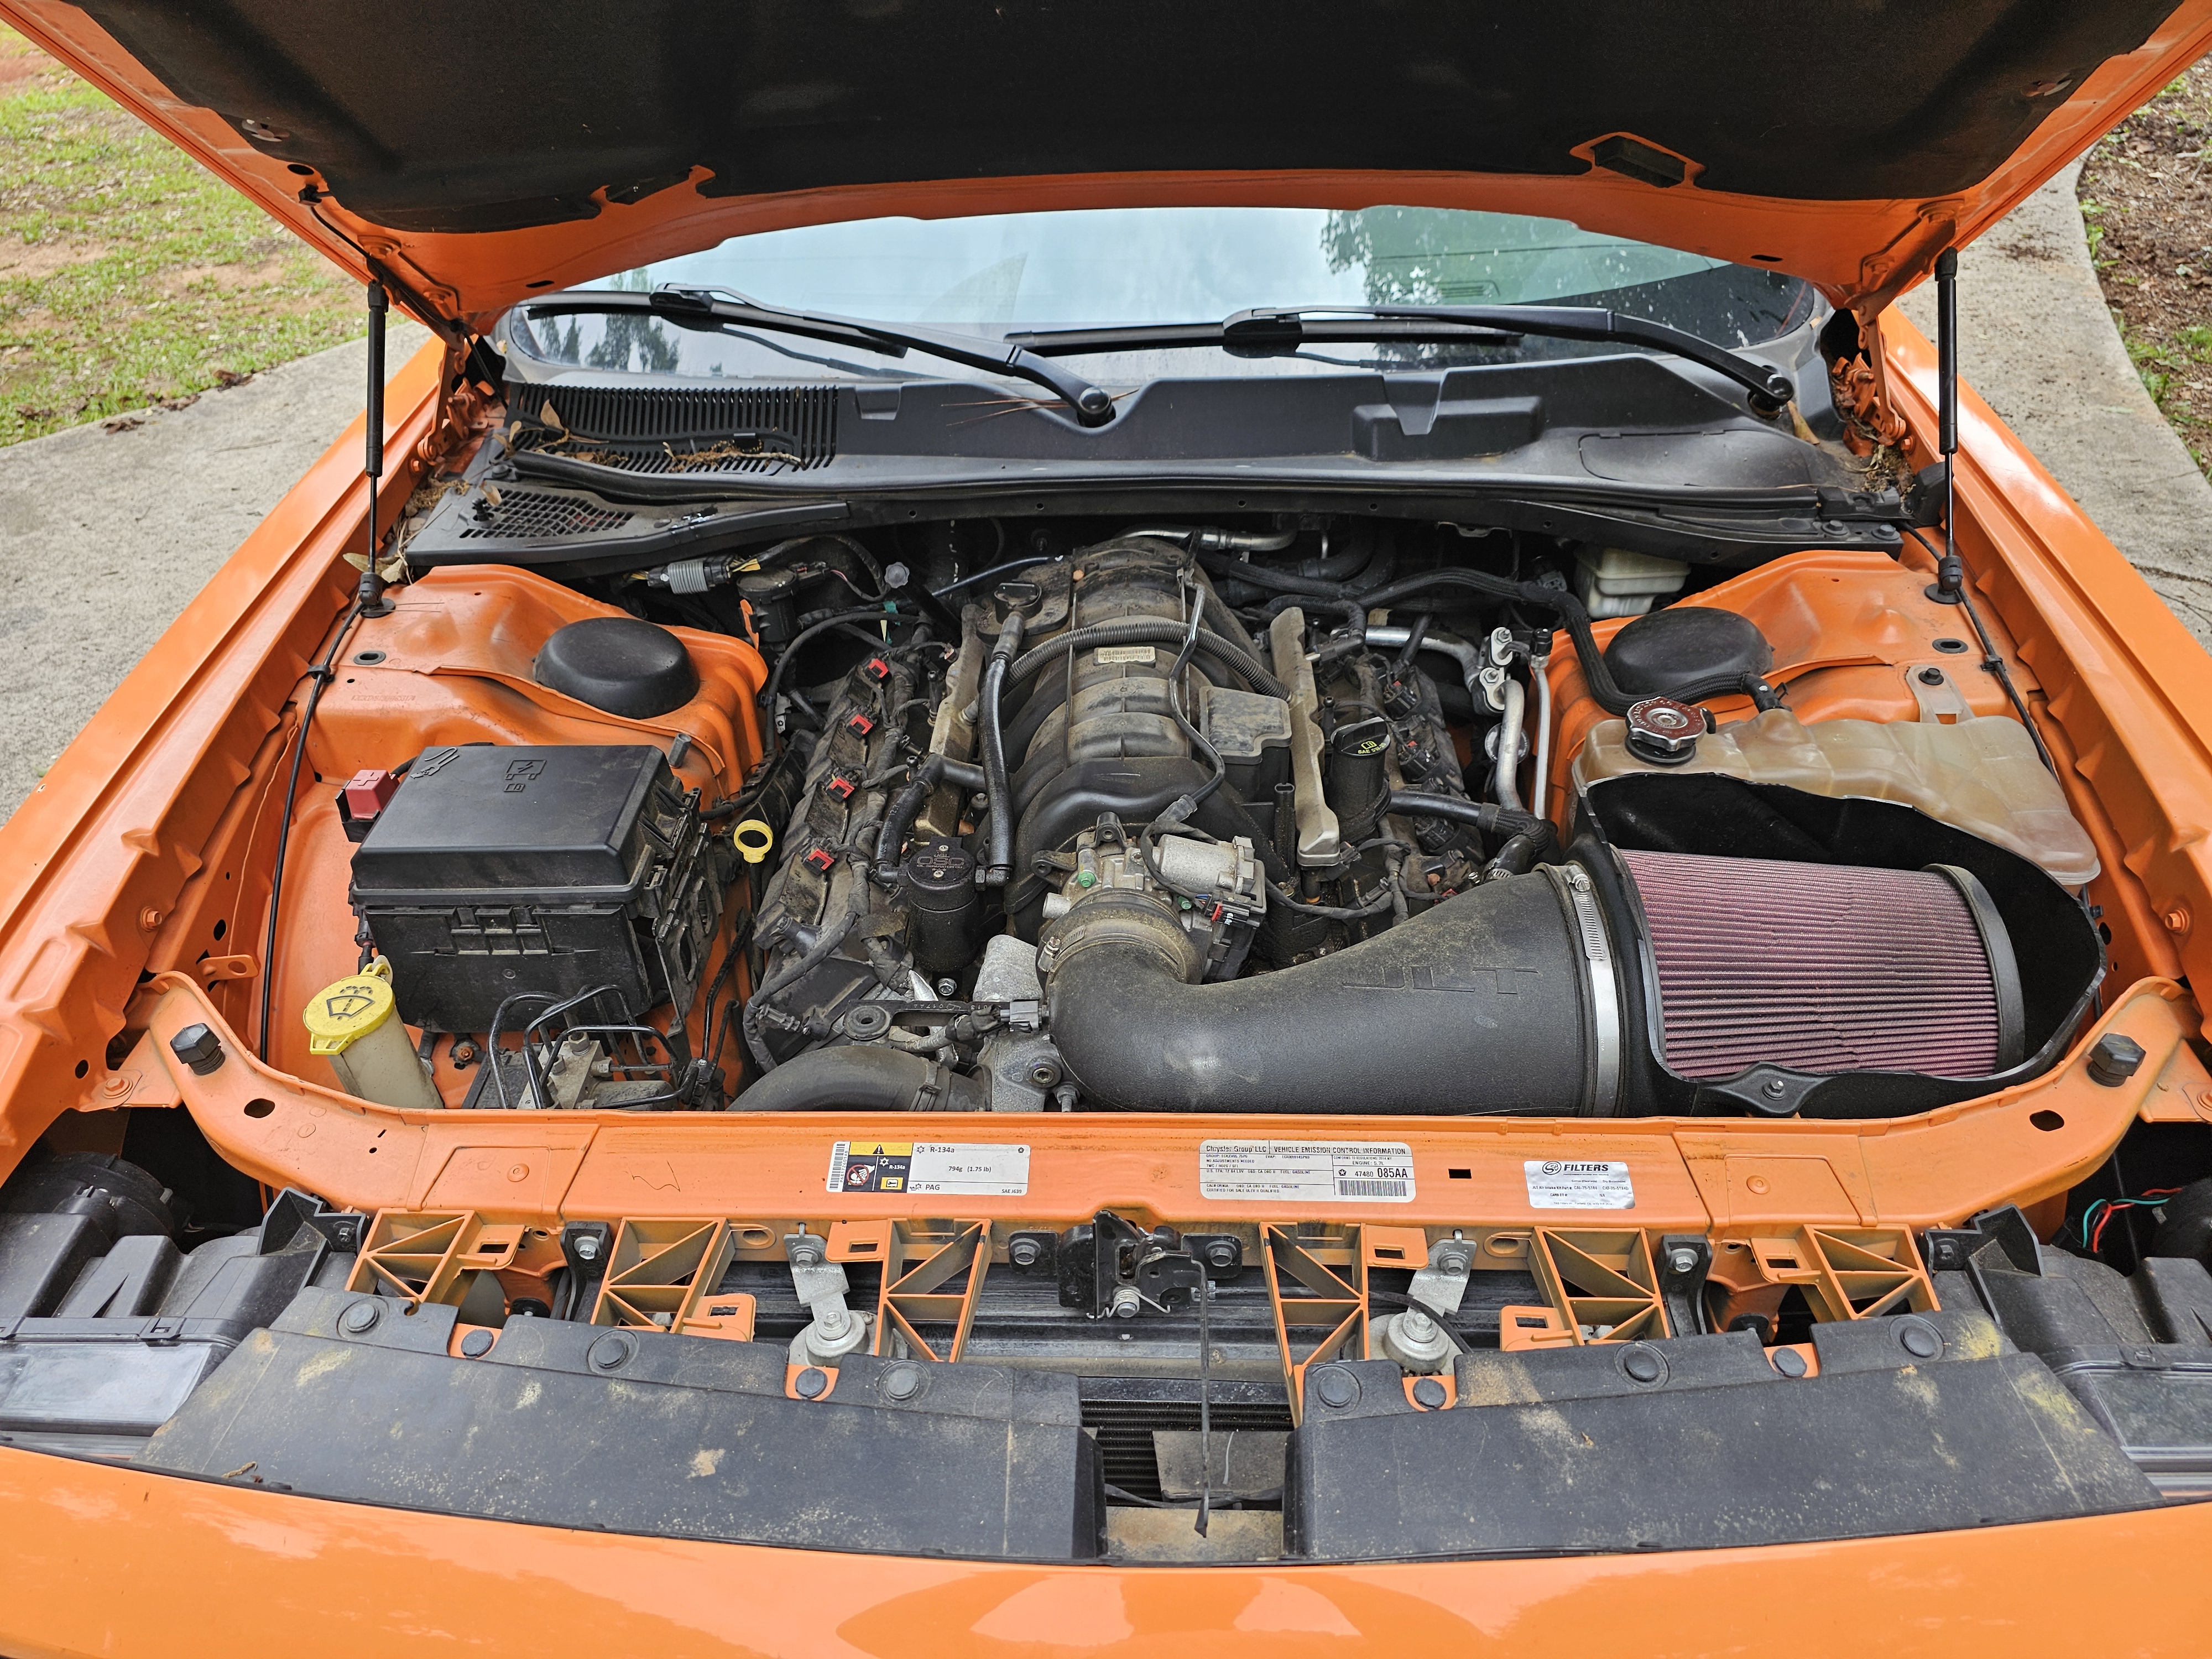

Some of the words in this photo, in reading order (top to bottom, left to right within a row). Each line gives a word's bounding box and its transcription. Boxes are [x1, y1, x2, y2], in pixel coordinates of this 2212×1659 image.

[917, 856, 964, 866] OSC
[1342, 967, 1539, 994] JLT
[1377, 1168, 1408, 1178] 085AA
